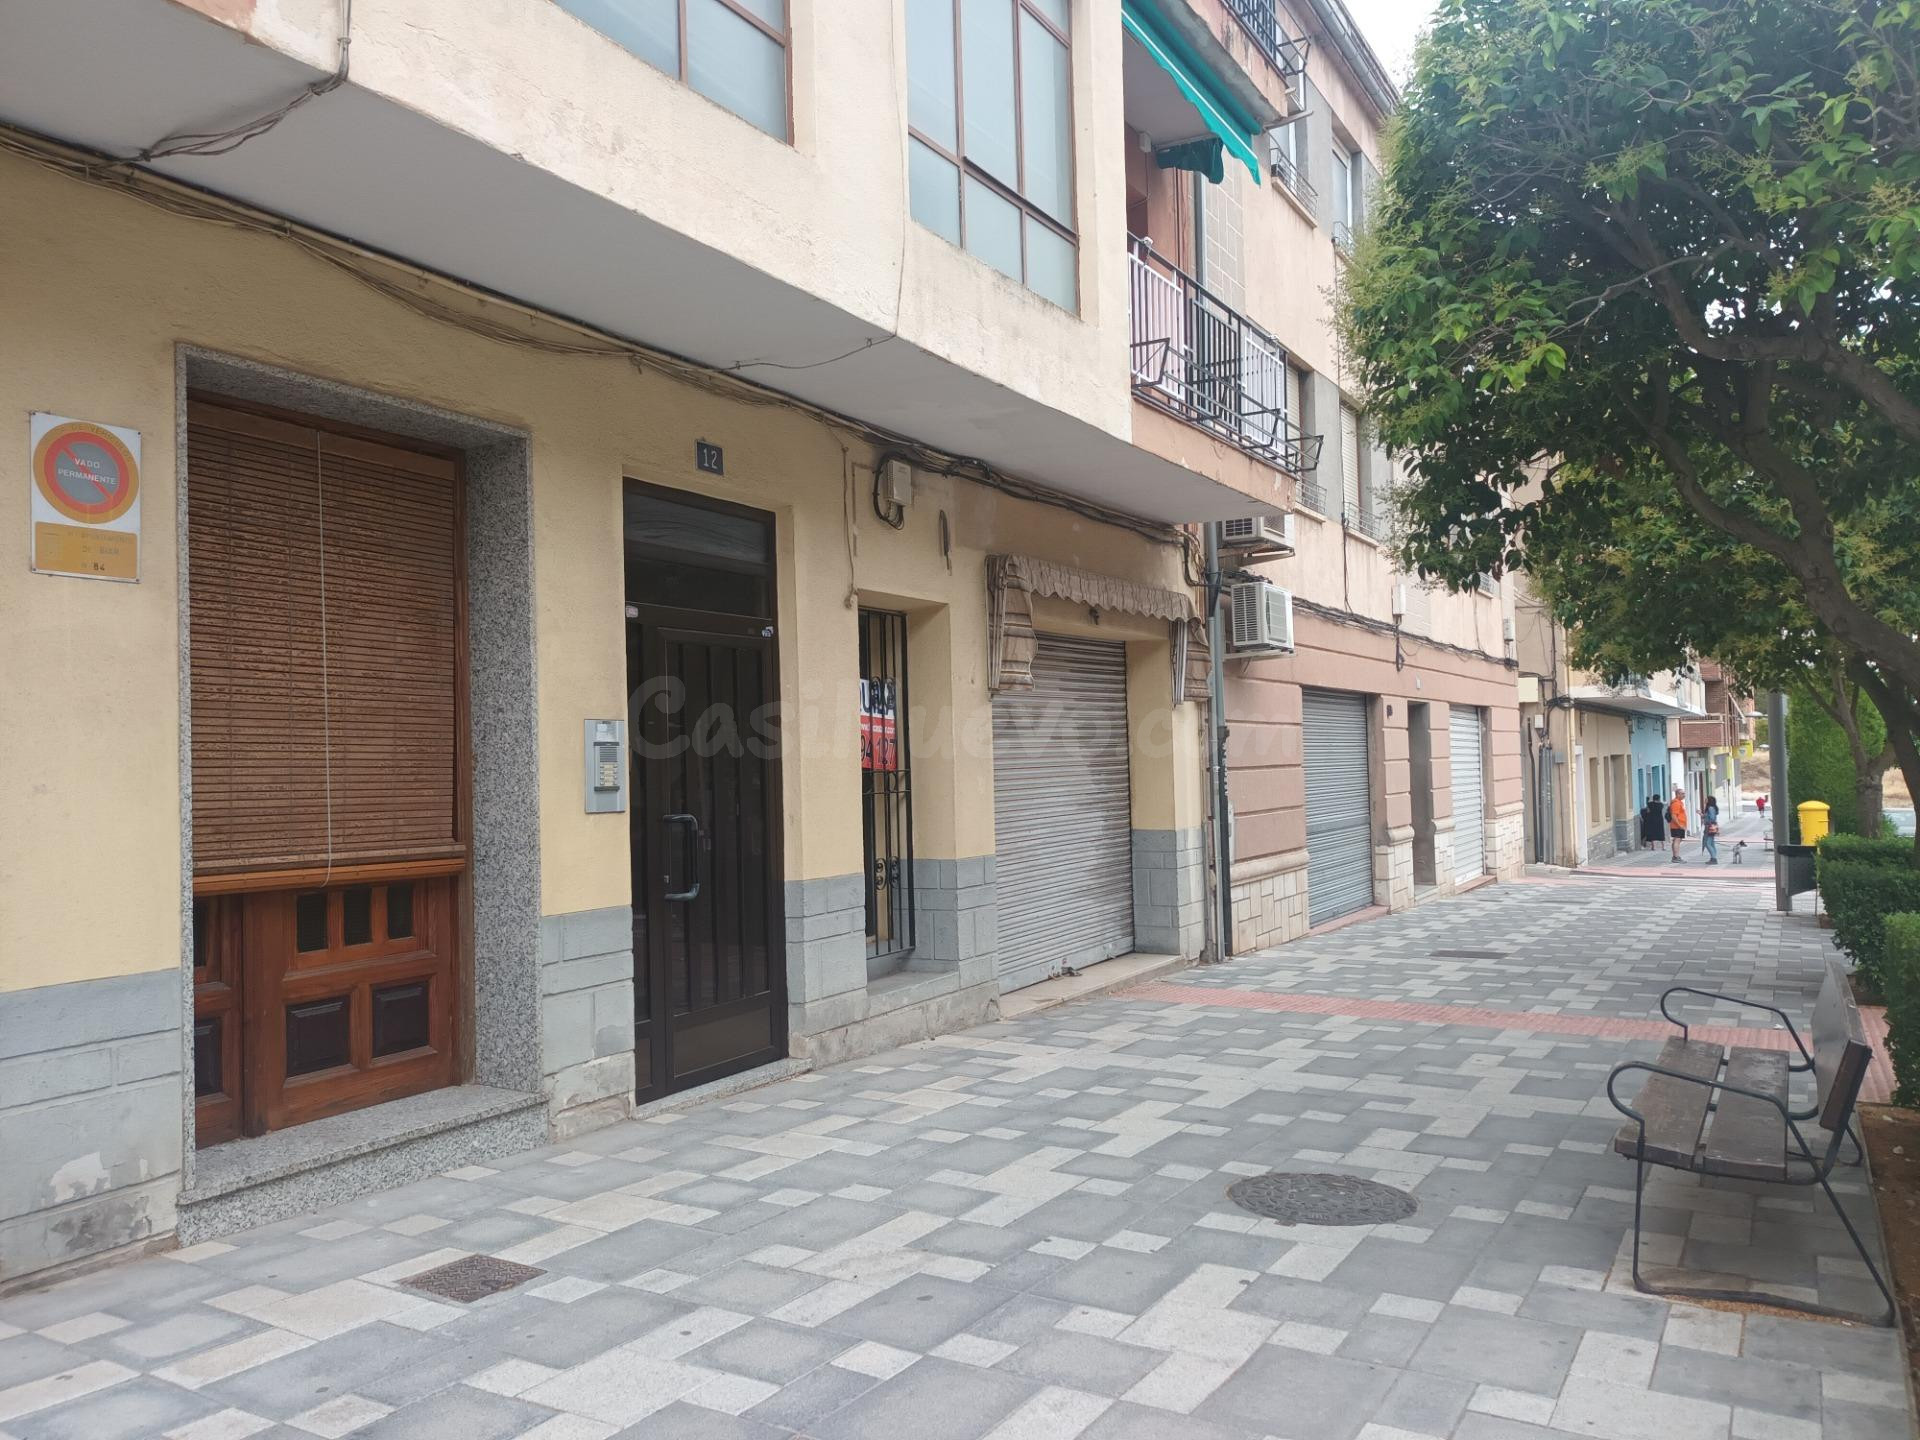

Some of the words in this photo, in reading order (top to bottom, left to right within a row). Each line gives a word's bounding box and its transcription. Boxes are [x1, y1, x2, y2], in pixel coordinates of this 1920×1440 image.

[74, 457, 101, 470] VADO
[703, 447, 718, 469] 12
[58, 467, 117, 486] PERMANENTE
